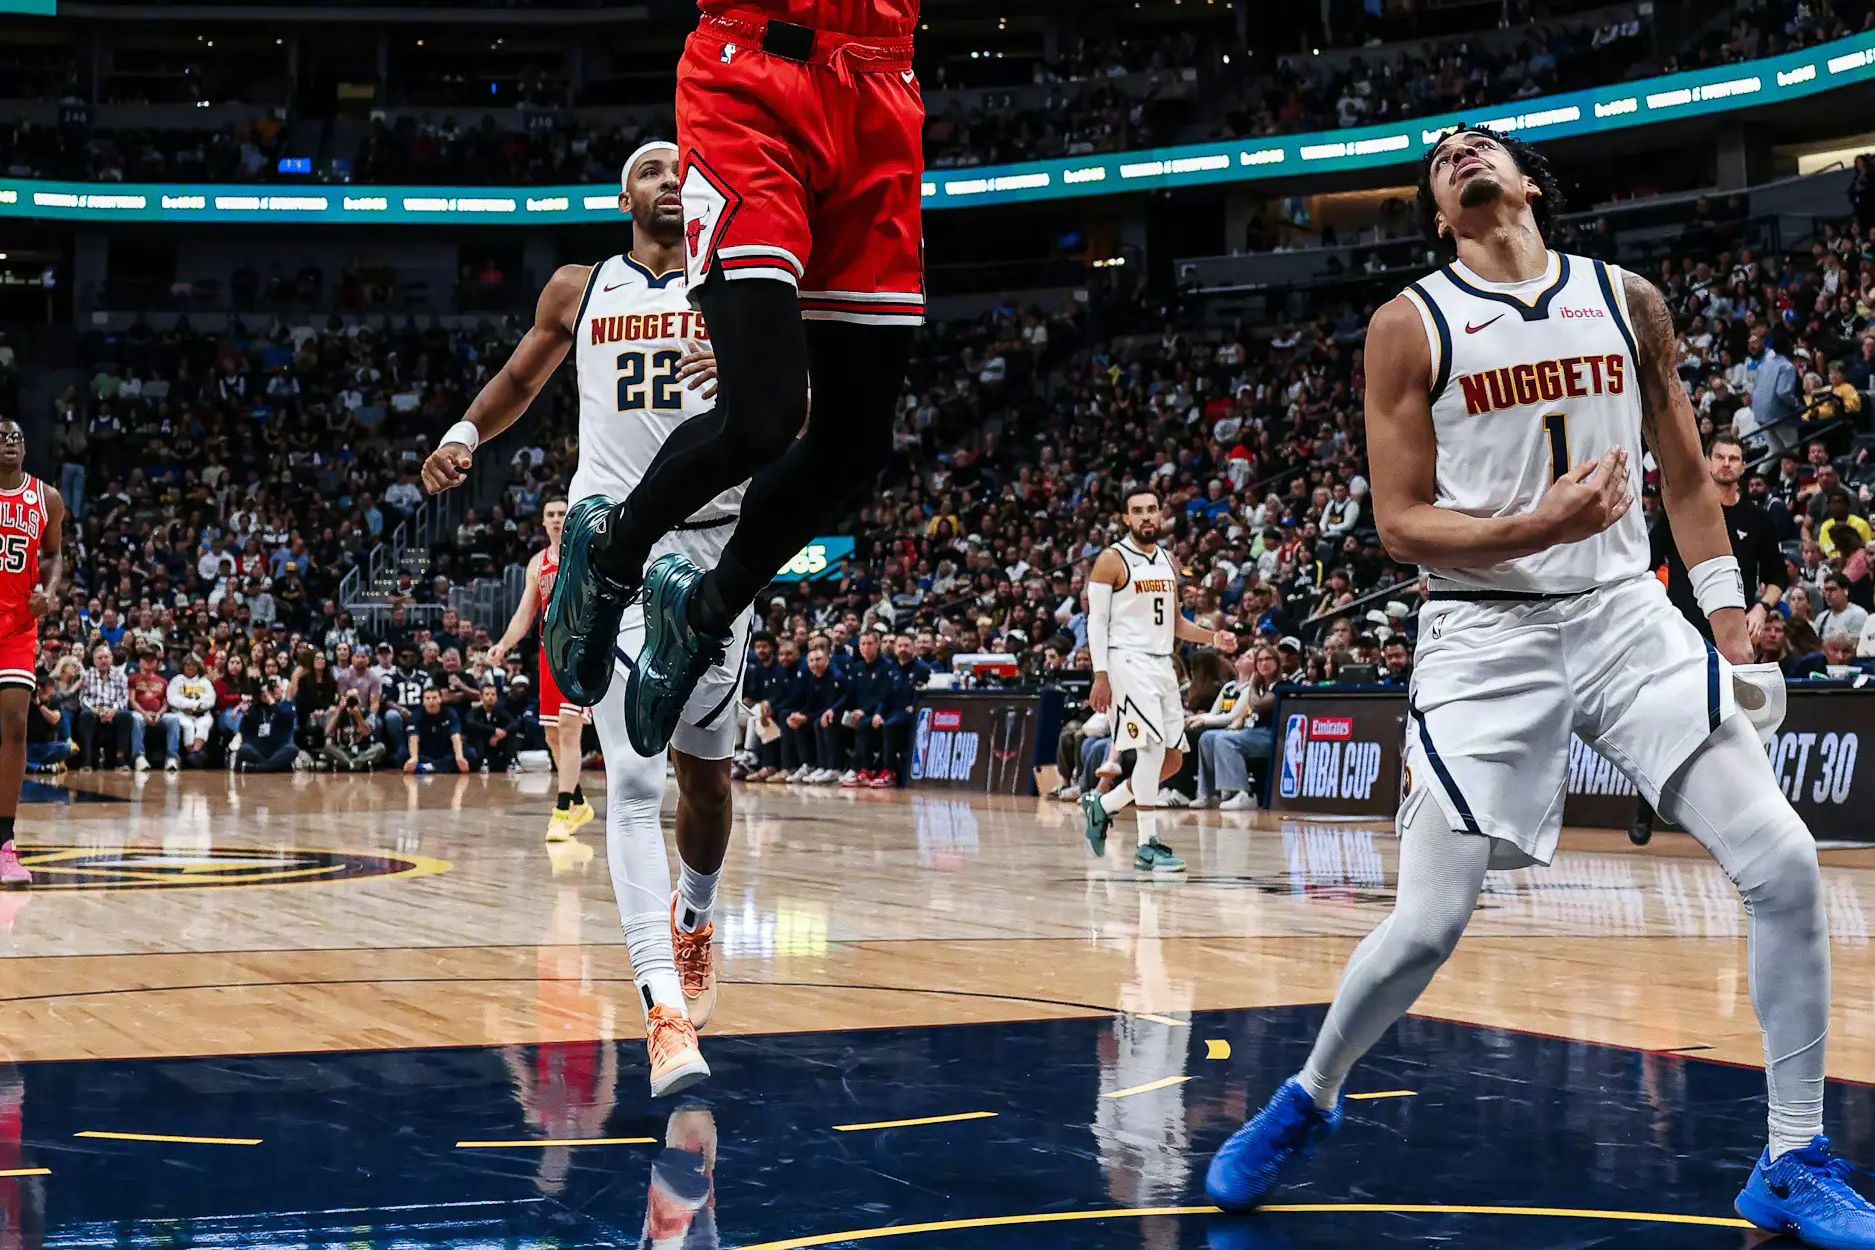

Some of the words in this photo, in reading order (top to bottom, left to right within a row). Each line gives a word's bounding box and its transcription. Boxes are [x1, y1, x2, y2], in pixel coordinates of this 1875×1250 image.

[1560, 307, 1604, 318] ibotta
[616, 350, 683, 412] 22
[1459, 354, 1624, 417] NUGGETS
[1543, 413, 1570, 486] 1
[0, 501, 40, 540] LLS
[0, 534, 29, 573] 5
[1134, 579, 1175, 594] NUGGET
[1154, 597, 1164, 626] 5
[397, 682, 421, 706] 12
[1312, 718, 1350, 736] Emirates
[950, 731, 979, 781] CUP
[1302, 741, 1341, 799] NBA
[1340, 741, 1381, 800] CUP
[1812, 732, 1859, 804] 30
